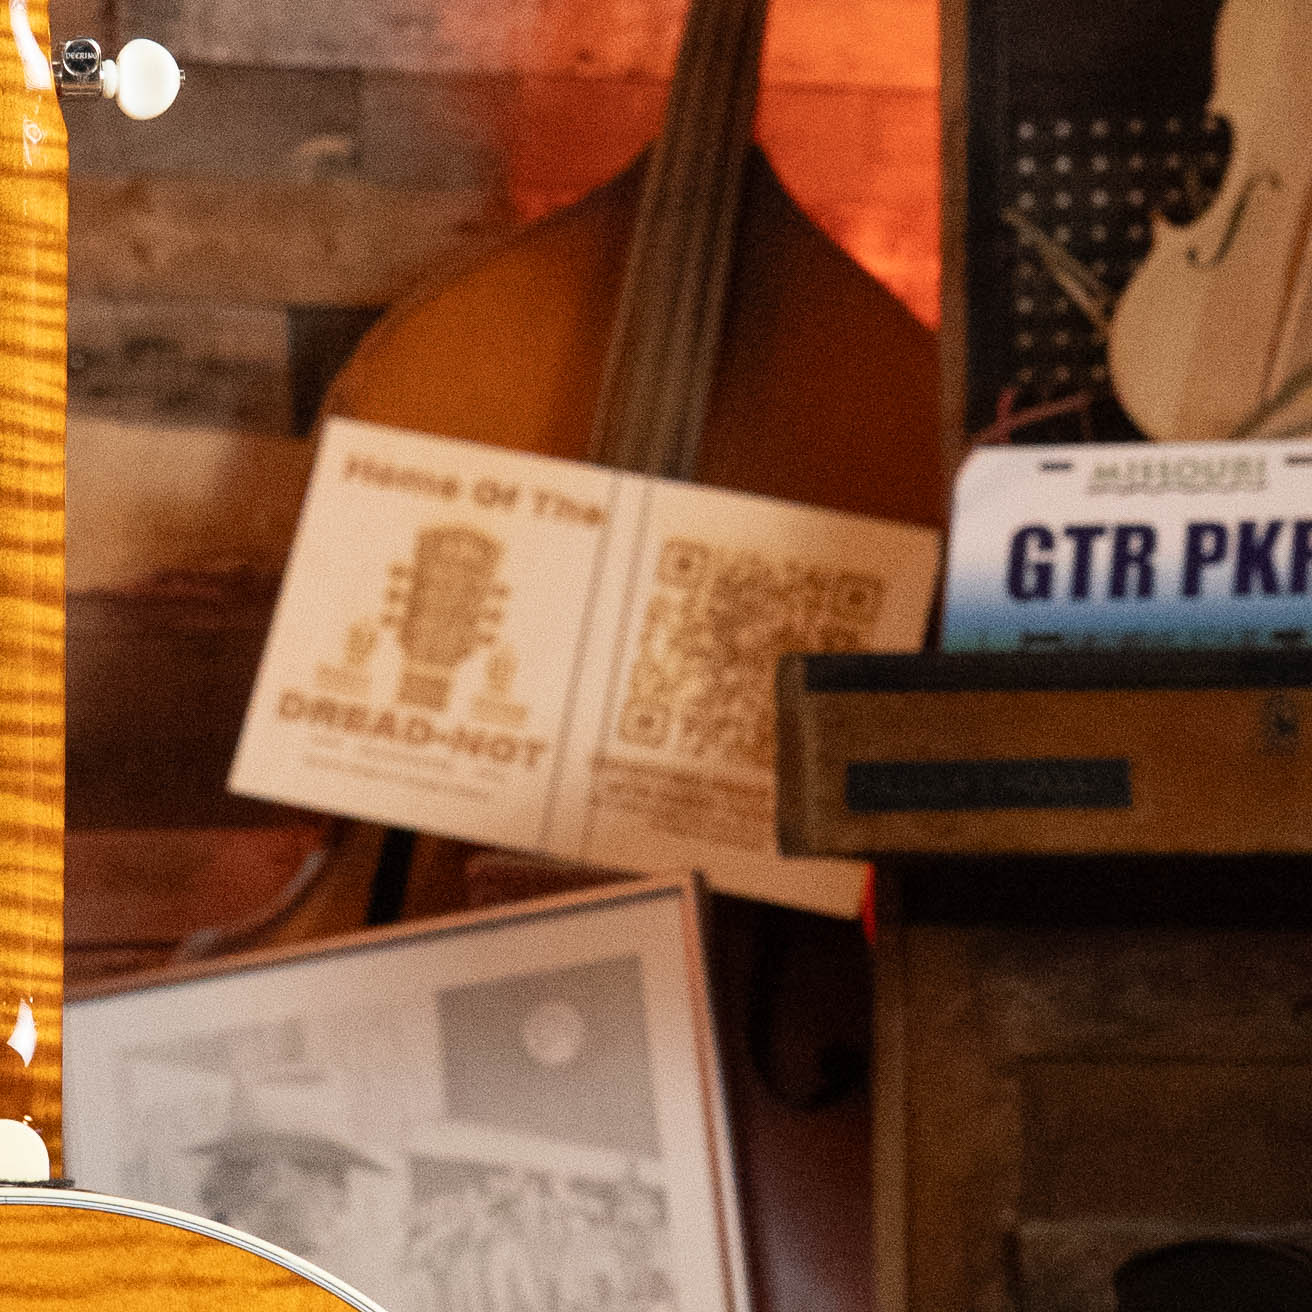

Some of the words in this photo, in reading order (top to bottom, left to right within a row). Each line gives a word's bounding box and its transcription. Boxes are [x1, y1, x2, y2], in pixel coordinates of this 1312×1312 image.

[343, 454, 458, 504] Home
[472, 475, 521, 511] Of
[532, 488, 609, 529] The
[1087, 456, 1267, 495] MISSOURI
[1006, 523, 1158, 601] GTR
[277, 689, 550, 770] DREAD-NOT
